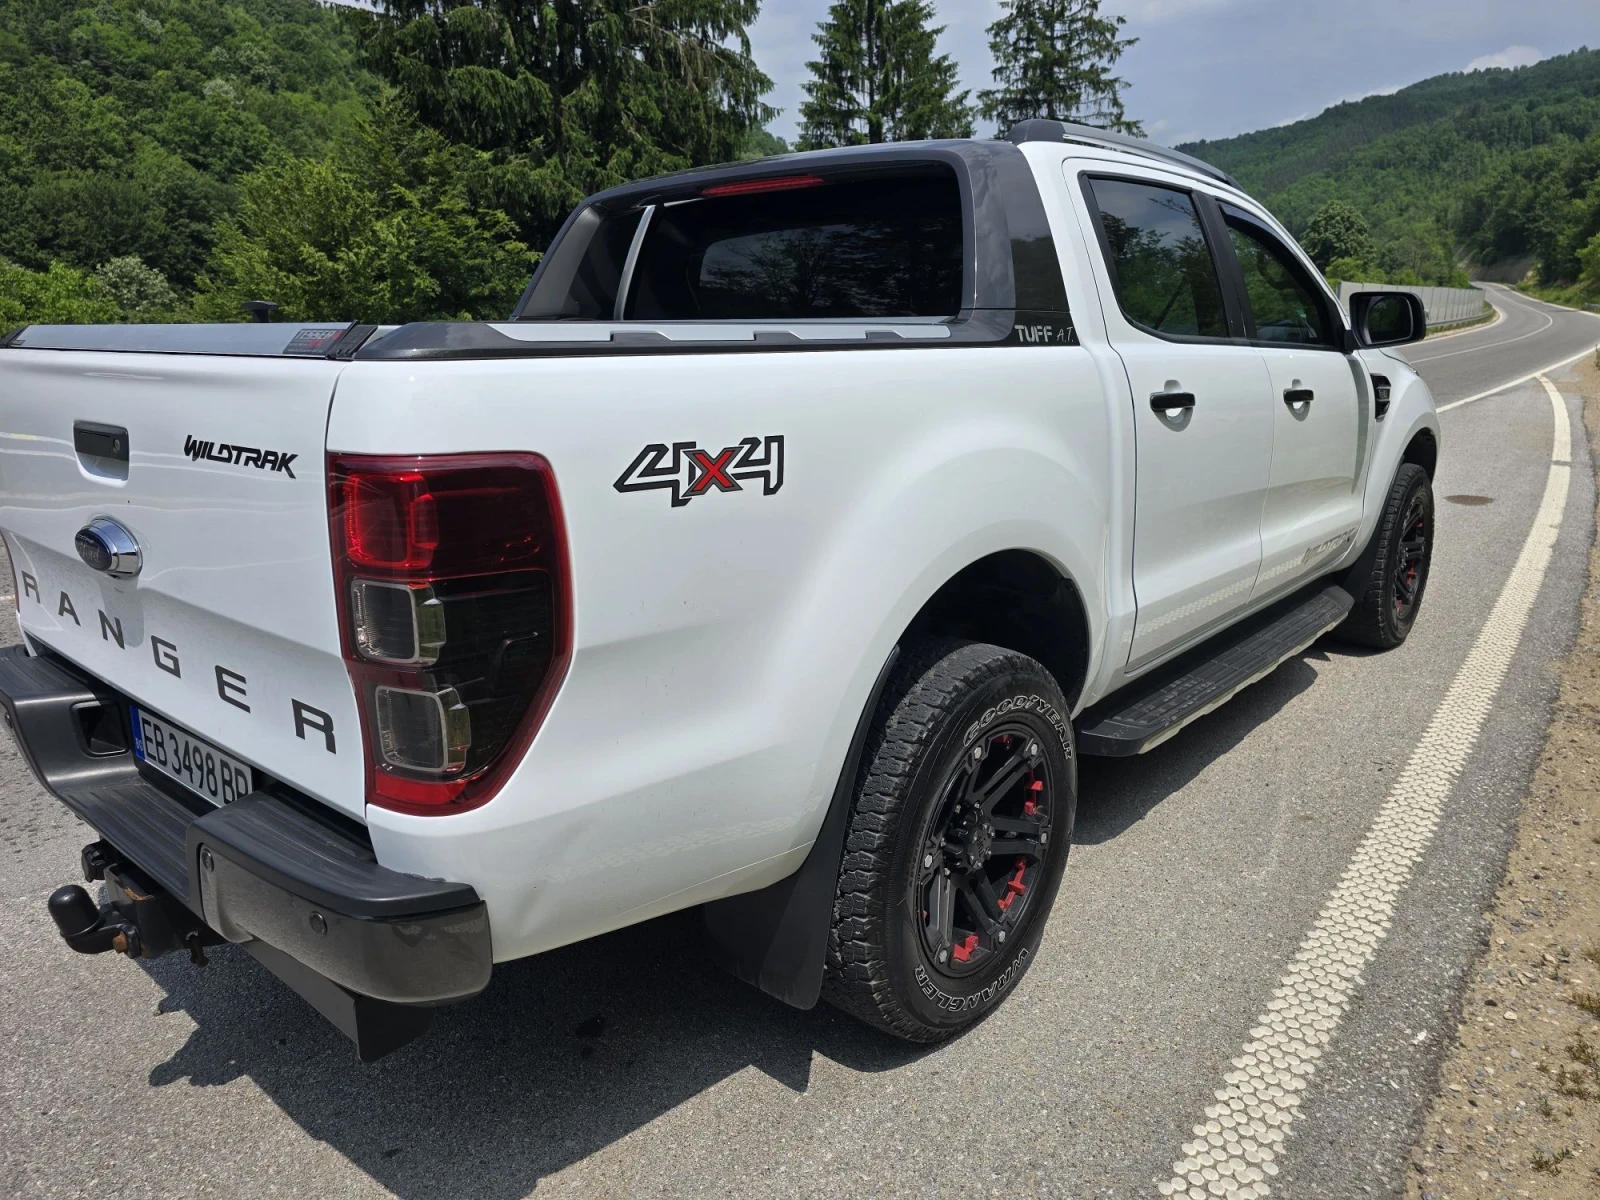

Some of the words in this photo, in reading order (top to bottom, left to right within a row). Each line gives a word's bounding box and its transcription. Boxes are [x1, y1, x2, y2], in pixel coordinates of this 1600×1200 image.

[1014, 324, 1053, 342] TUFF
[183, 434, 298, 480] WILDTRAK
[20, 569, 337, 755] RANGER
[141, 717, 168, 767] EB
[169, 732, 218, 798] 3498
[963, 694, 1073, 760] GOODYEAR
[914, 948, 1029, 1012] WRANGLER
